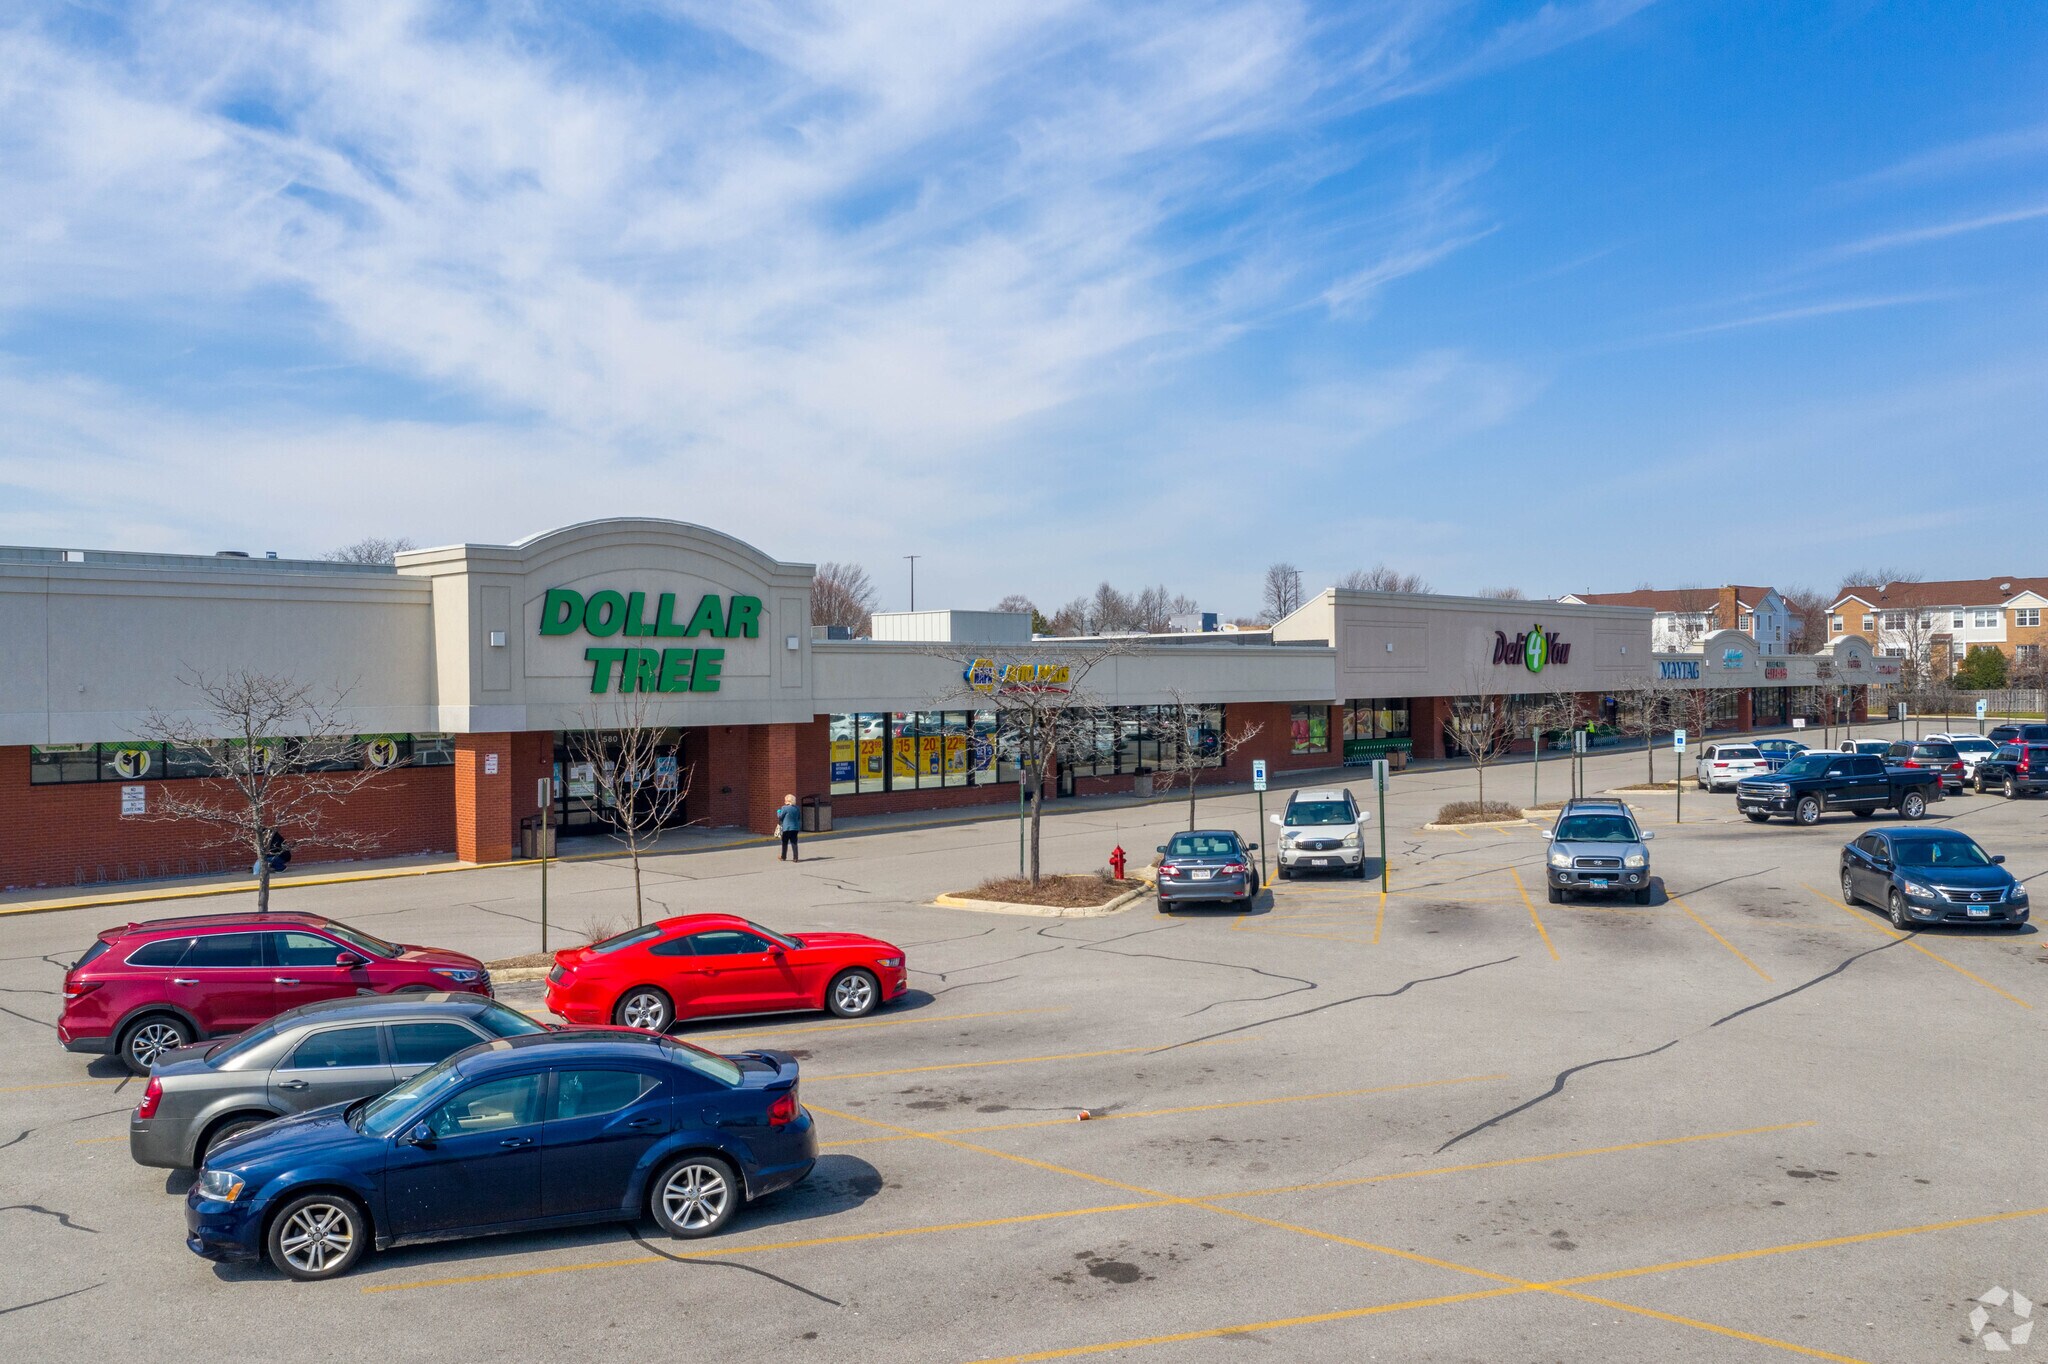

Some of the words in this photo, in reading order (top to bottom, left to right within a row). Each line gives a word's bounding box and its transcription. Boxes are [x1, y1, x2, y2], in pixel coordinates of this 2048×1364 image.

[539, 589, 763, 638] DOLLAR
[1493, 631, 1525, 665] Deli
[1528, 633, 1542, 669] 4
[1544, 632, 1571, 665] You
[585, 648, 725, 693] TREE
[1660, 661, 1699, 680] MAYTAG
[603, 735, 618, 743] 580
[121, 753, 141, 777] $1
